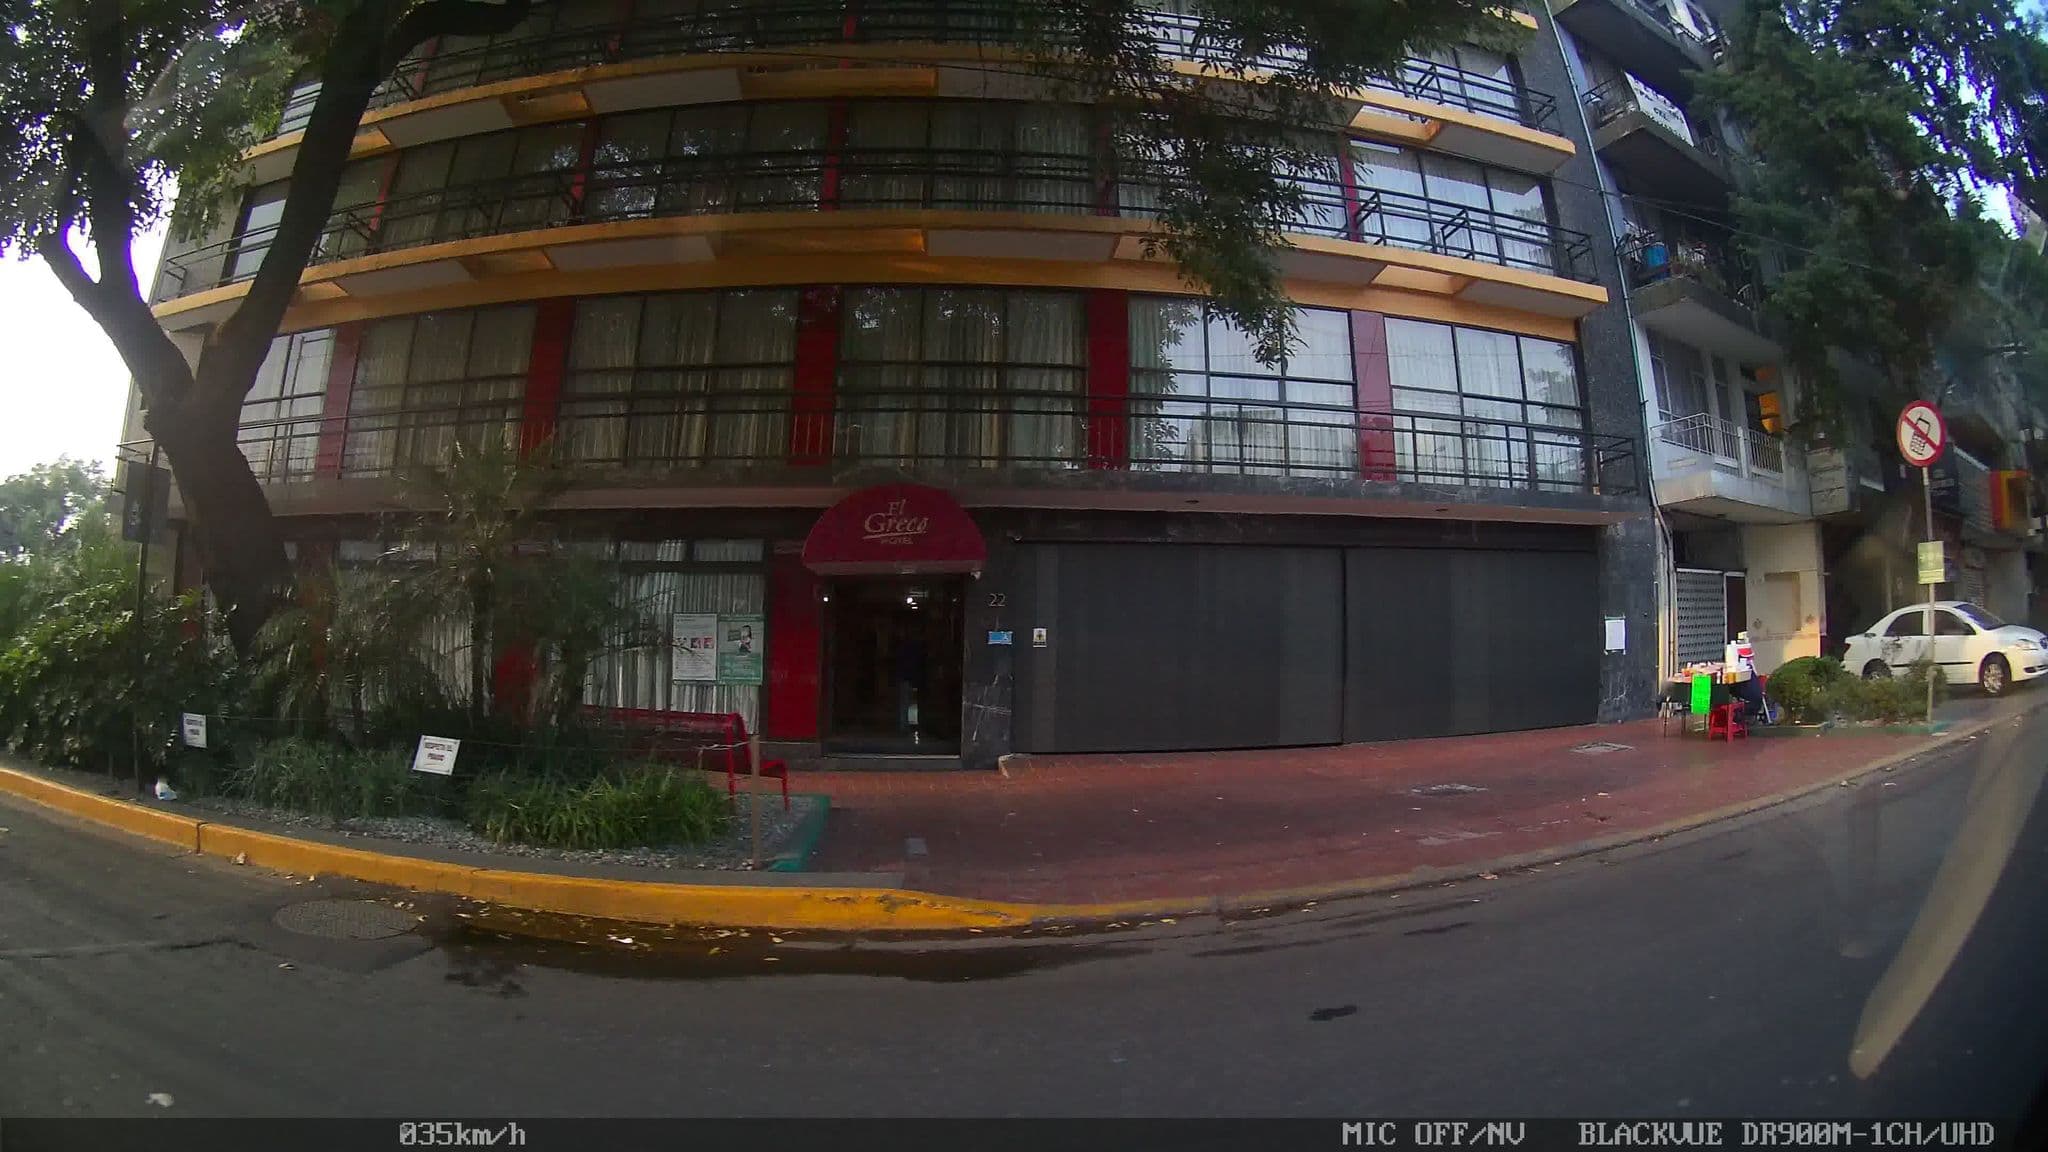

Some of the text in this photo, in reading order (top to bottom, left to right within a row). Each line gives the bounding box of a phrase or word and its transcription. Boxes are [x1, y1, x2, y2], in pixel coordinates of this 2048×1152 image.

[887, 499, 907, 516] El
[864, 512, 929, 534] Greco
[988, 592, 1007, 608] 22
